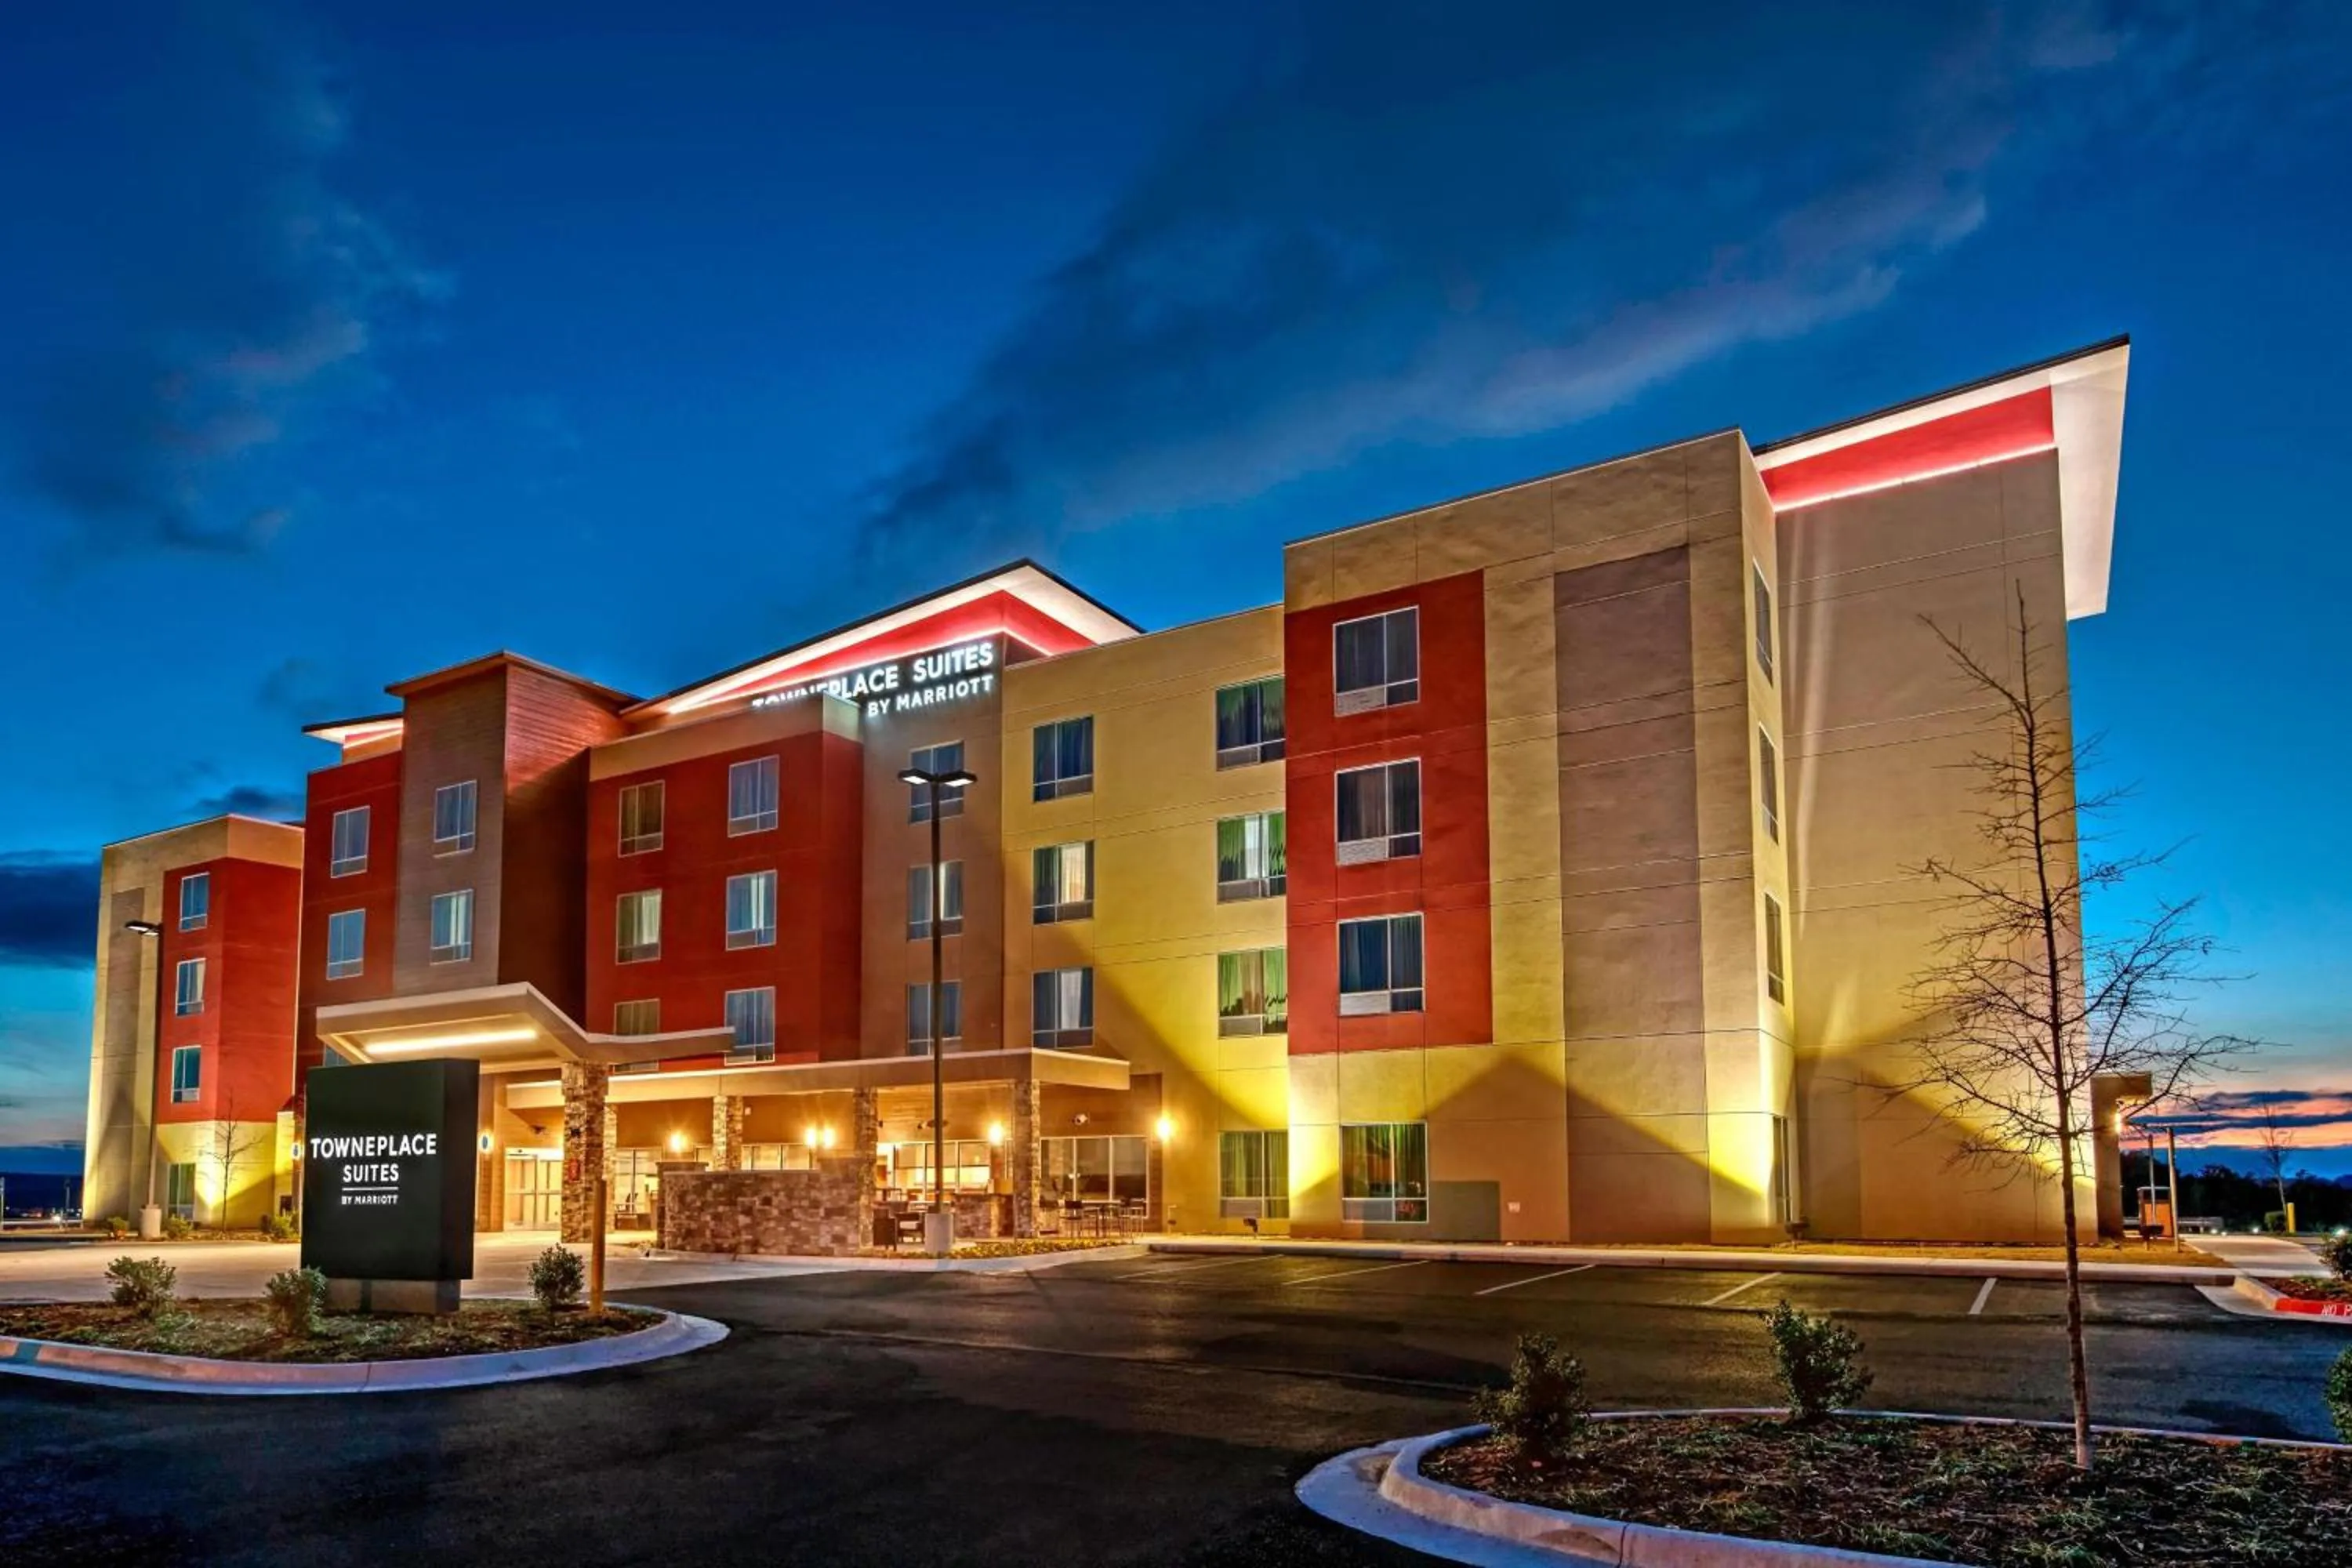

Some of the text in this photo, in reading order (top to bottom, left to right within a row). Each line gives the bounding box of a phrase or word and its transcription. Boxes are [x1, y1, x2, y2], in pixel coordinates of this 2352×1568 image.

[752, 643, 993, 707] PLACE SUITES
[868, 675, 994, 718] BY MARRIOTT
[310, 1134, 437, 1159] TOWNEPLACE
[343, 1163, 400, 1183] SUITES
[341, 1194, 399, 1205] BY MARRIOTT
